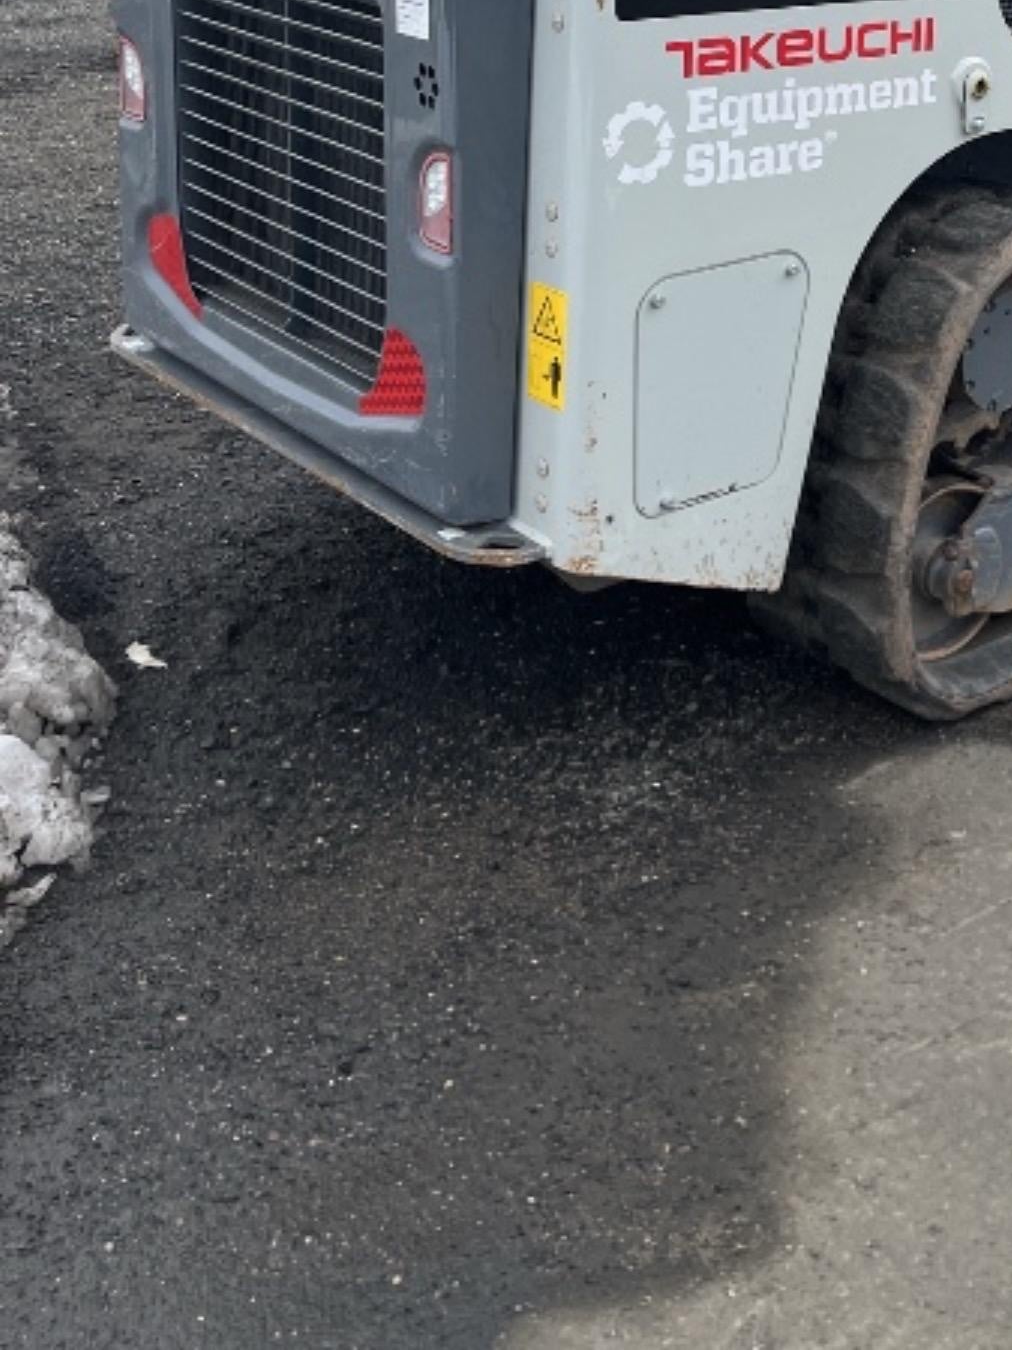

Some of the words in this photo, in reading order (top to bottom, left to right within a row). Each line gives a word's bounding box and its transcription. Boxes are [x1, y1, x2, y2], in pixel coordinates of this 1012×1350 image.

[665, 17, 935, 79] TAKEUCHI
[686, 67, 938, 135] Equipment
[683, 140, 824, 188] Share
